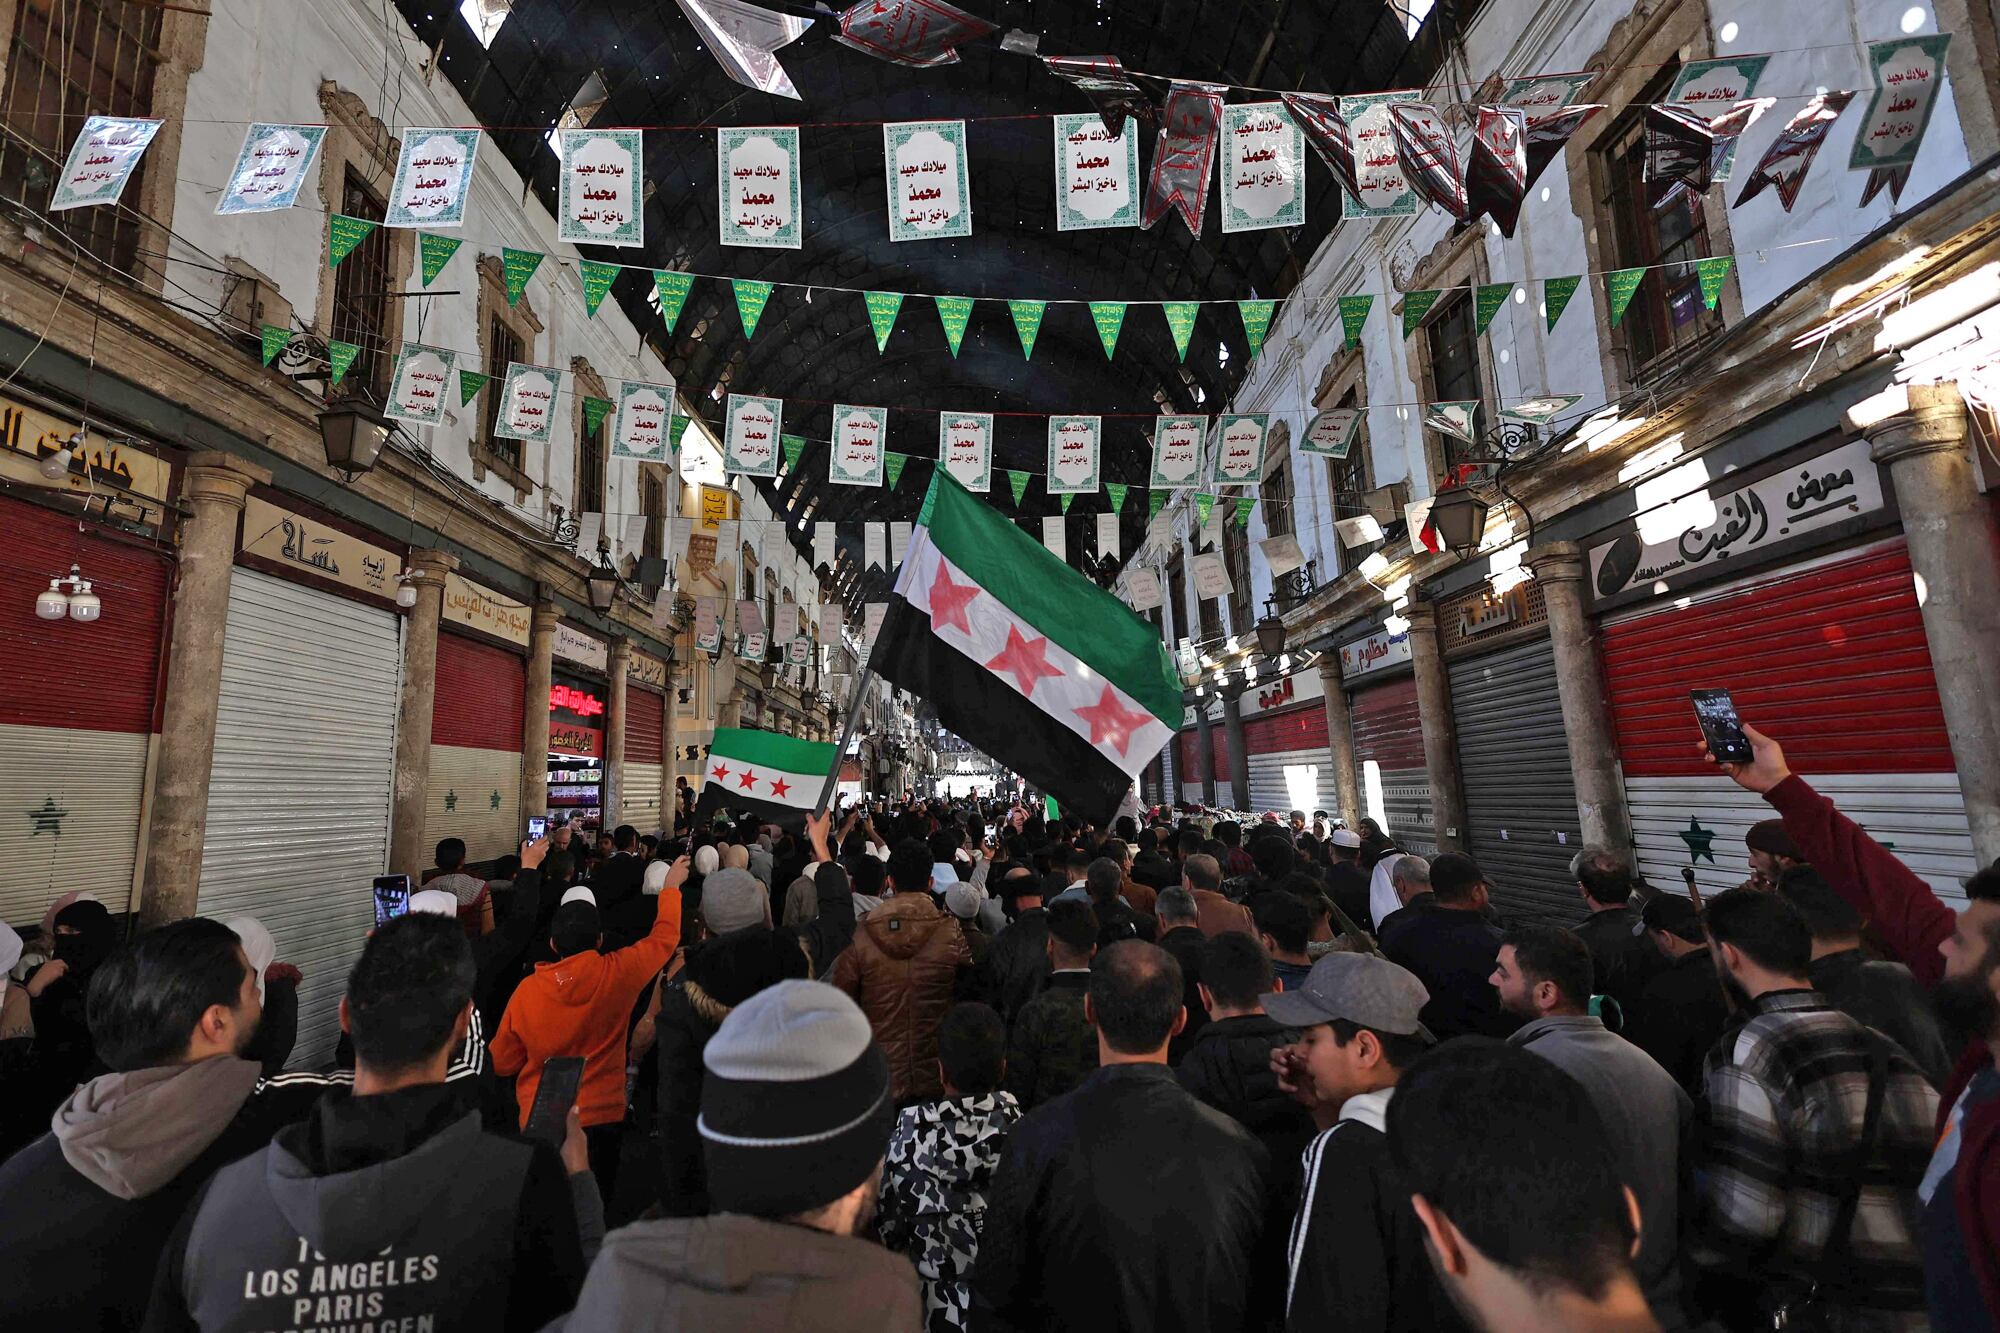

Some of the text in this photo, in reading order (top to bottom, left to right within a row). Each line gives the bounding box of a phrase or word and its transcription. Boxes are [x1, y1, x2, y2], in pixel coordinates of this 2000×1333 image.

[1070, 177, 1094, 192] البشر
[1235, 172, 1258, 189] البشر
[405, 196, 427, 208] البشر
[576, 208, 600, 223] البشر
[736, 212, 758, 228] البشر
[904, 209, 926, 225] البشر
[244, 1254, 440, 1299] LOS ANGELES
[293, 1292, 384, 1325] PARIS
